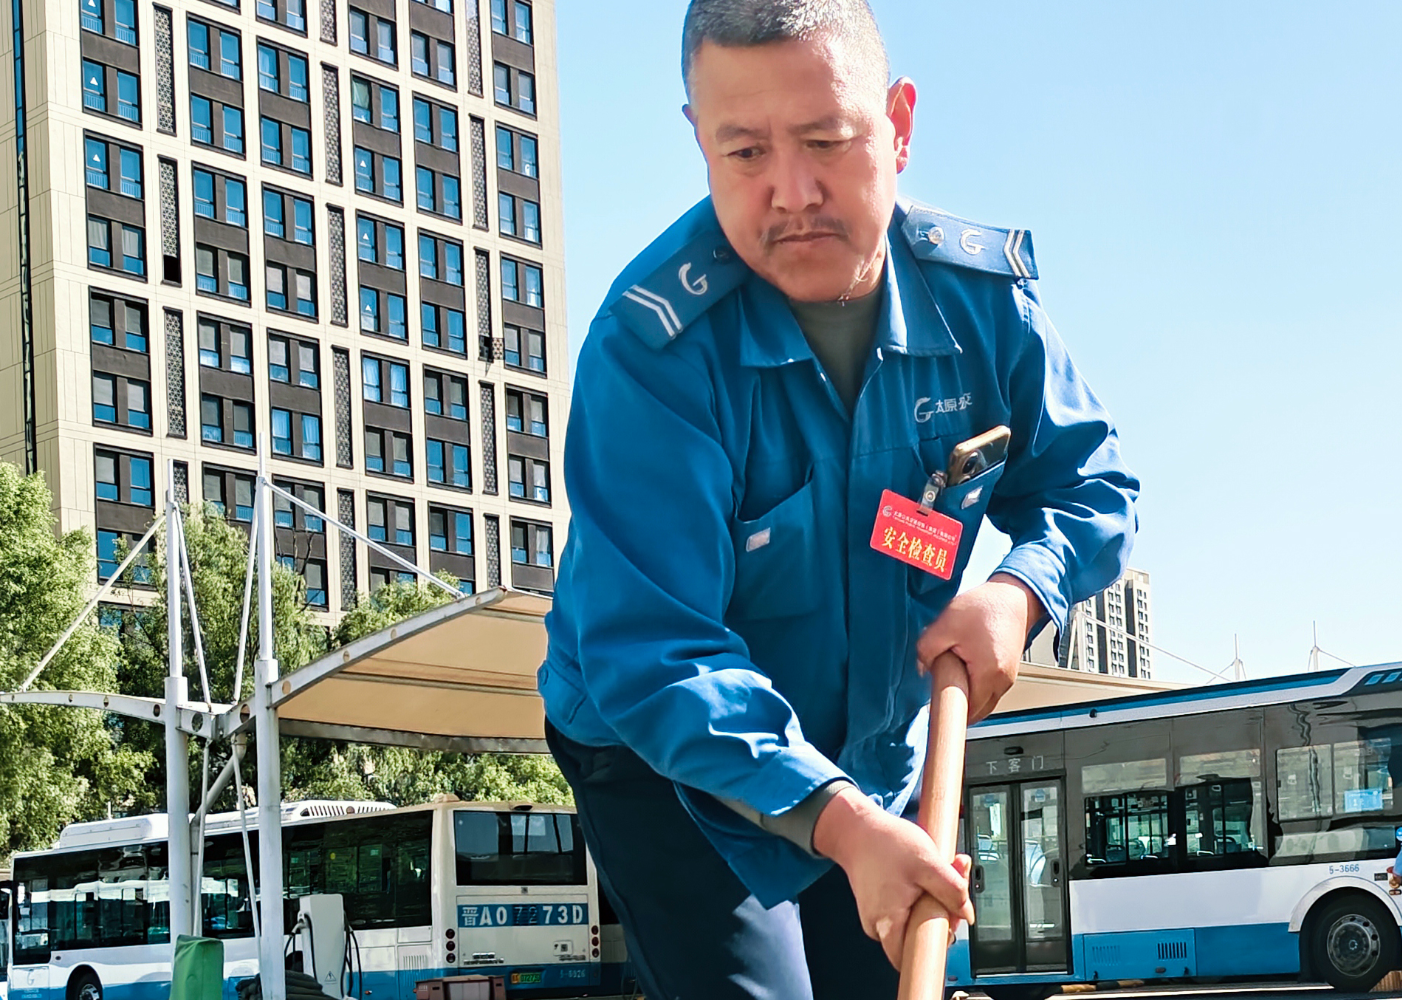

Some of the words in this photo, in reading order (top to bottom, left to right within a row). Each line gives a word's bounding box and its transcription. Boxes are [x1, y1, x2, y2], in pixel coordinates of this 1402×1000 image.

[882, 526, 948, 572] 安全检查员
[986, 755, 1044, 775] 下客门
[461, 905, 583, 927] 晋A07273D
